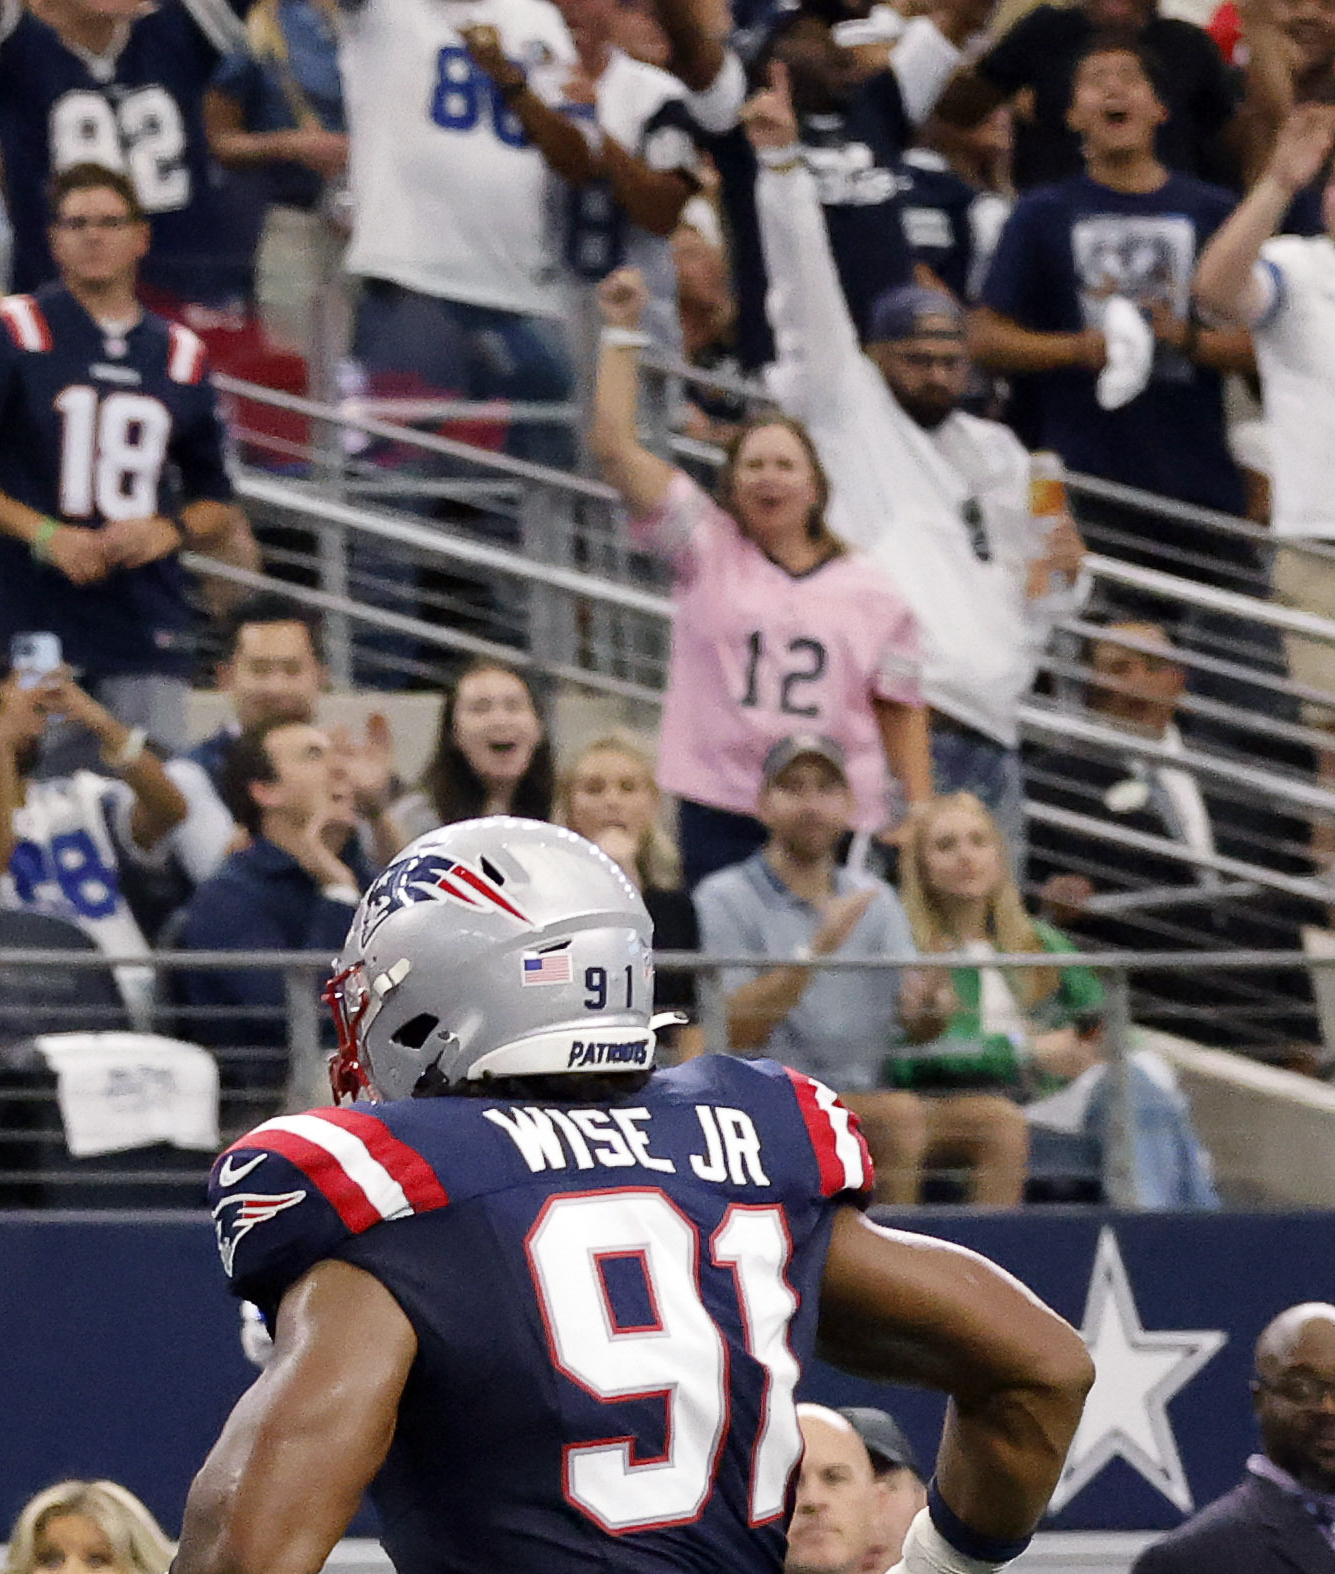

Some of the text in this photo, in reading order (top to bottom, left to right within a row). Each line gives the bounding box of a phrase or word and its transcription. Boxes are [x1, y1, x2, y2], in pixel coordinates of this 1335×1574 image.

[53, 384, 173, 521] 18
[741, 630, 827, 717] 12
[584, 964, 633, 1011] 91
[484, 1105, 771, 1186] WISE JR
[525, 1186, 803, 1535] 91
